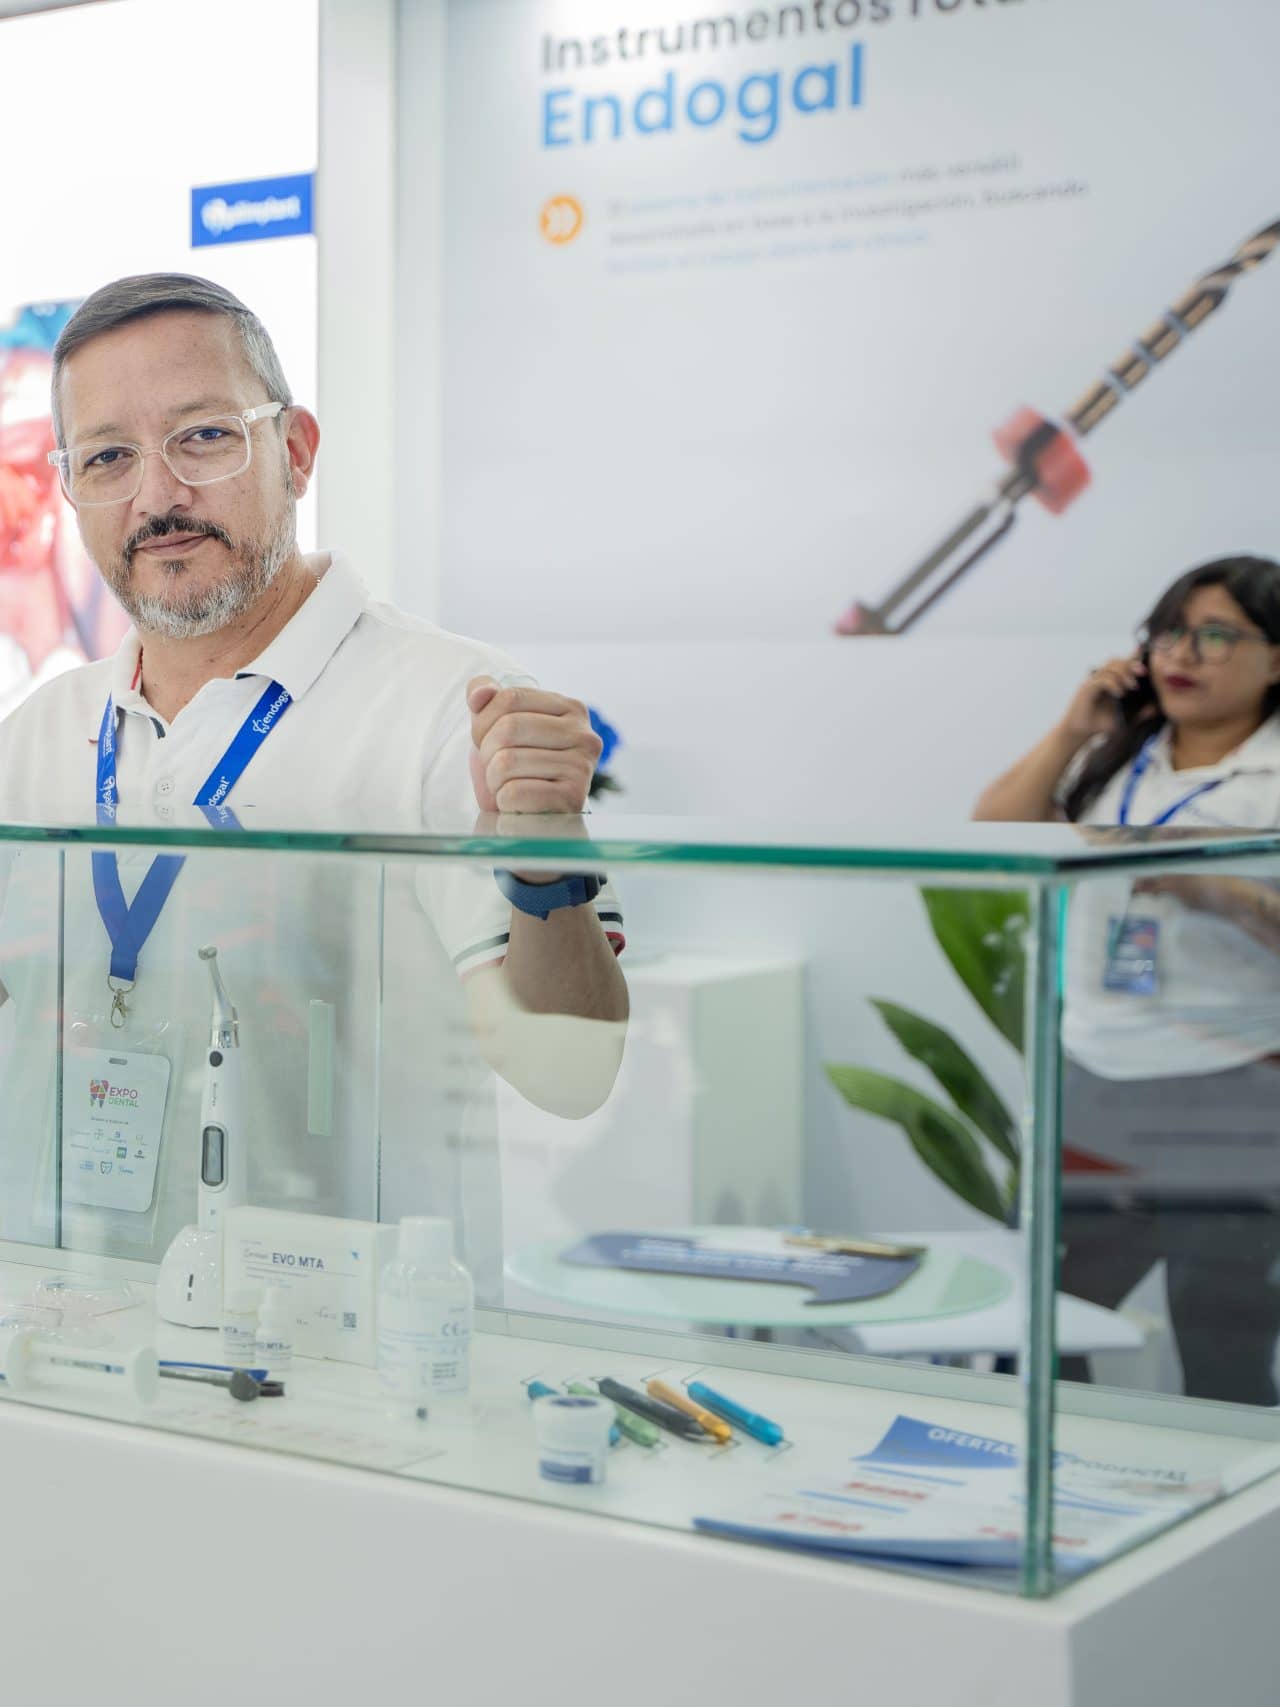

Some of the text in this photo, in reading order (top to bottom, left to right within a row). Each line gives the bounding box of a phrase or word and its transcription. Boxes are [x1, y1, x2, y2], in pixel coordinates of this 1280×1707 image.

[540, 0, 892, 74] Instrumentos
[540, 43, 867, 149] Endogal
[208, 776, 230, 807] dogal
[108, 1098, 140, 1109] DENTAL
[109, 1086, 139, 1100] EXPO
[271, 1252, 297, 1267] EVO
[298, 1256, 326, 1271] MTA
